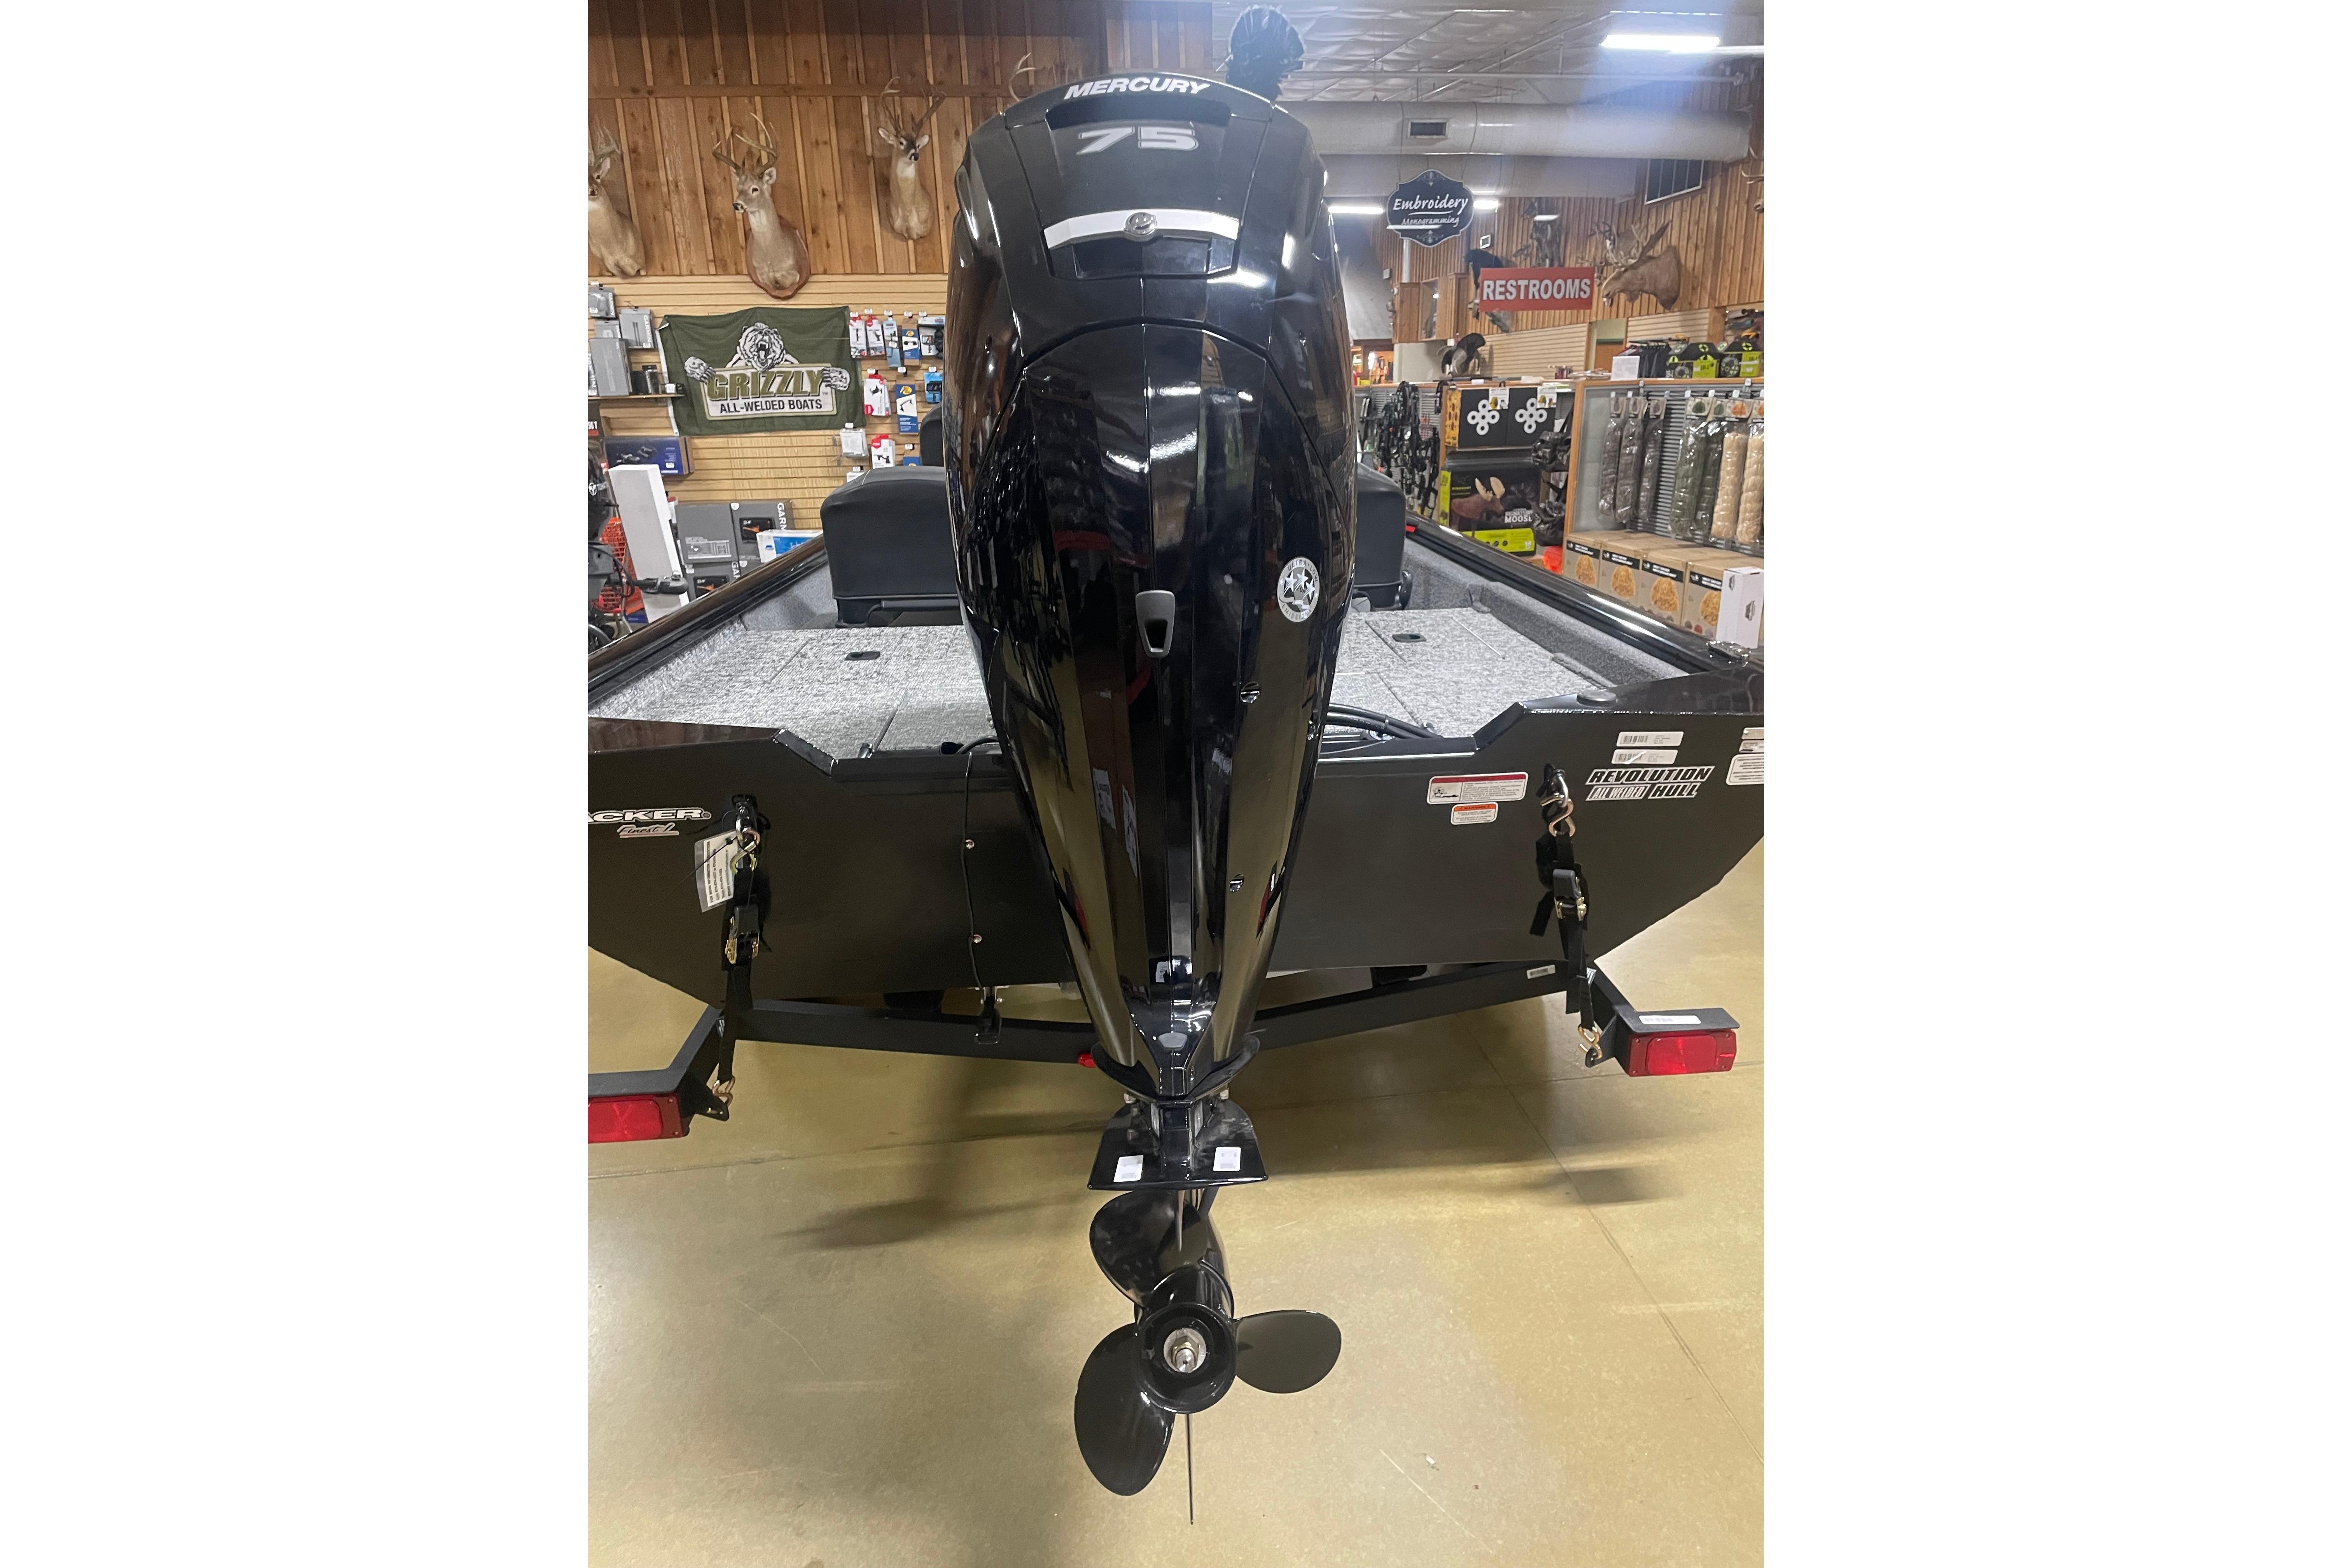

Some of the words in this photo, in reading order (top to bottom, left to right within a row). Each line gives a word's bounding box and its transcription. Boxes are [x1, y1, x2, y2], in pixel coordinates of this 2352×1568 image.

[1064, 77, 1211, 99] MERCURY
[1076, 126, 1198, 155] 75
[1393, 194, 1468, 215] Embroidery
[1401, 215, 1460, 228] Monogramming
[1482, 278, 1591, 301] RESTROOMS
[643, 315, 652, 343] GARMIN
[707, 370, 823, 401] GRIZZLY
[720, 400, 785, 413] ALL-WELDED
[788, 399, 822, 409] BOATS
[1588, 767, 1712, 783] REVOLUTION
[1593, 787, 1608, 799] ALL
[1609, 786, 1645, 798] WELDED
[1651, 784, 1698, 798] HULL
